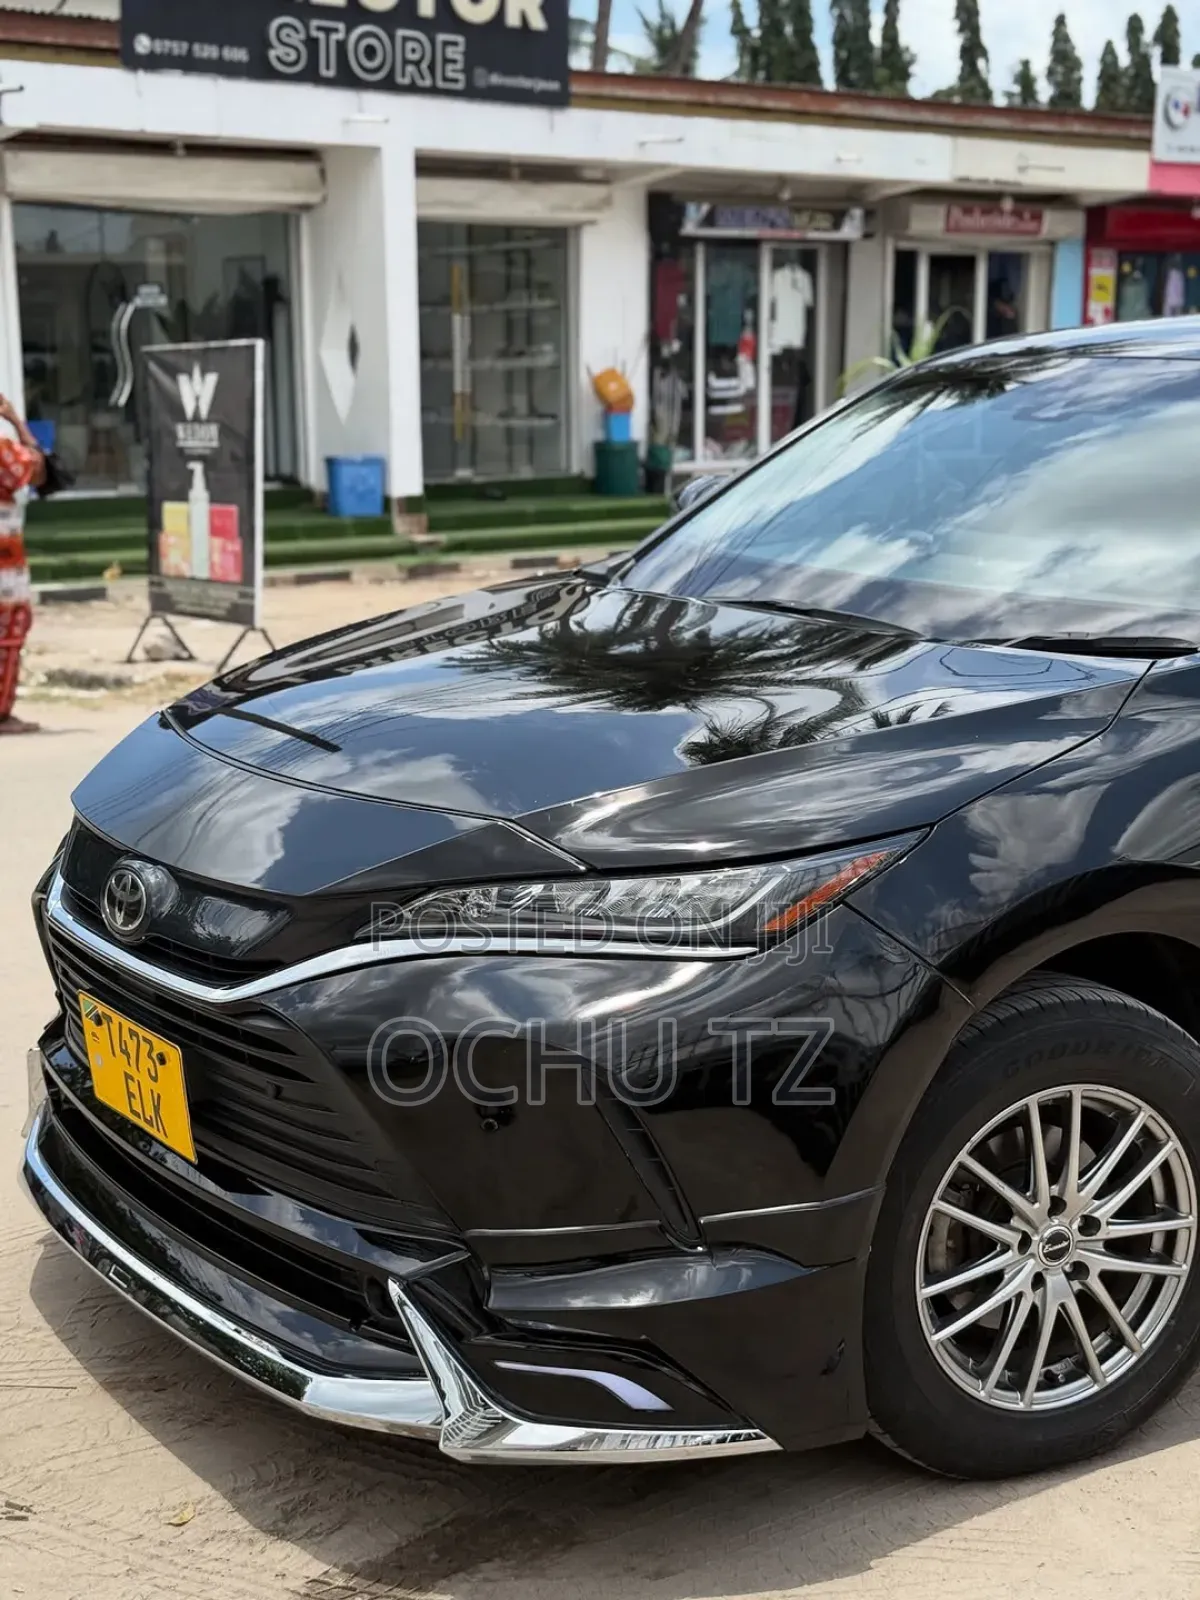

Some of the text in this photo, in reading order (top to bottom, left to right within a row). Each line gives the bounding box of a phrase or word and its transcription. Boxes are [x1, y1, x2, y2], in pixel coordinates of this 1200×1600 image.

[268, 15, 466, 90] STORE
[101, 1013, 159, 1083] T473
[123, 1069, 168, 1139] ELK
